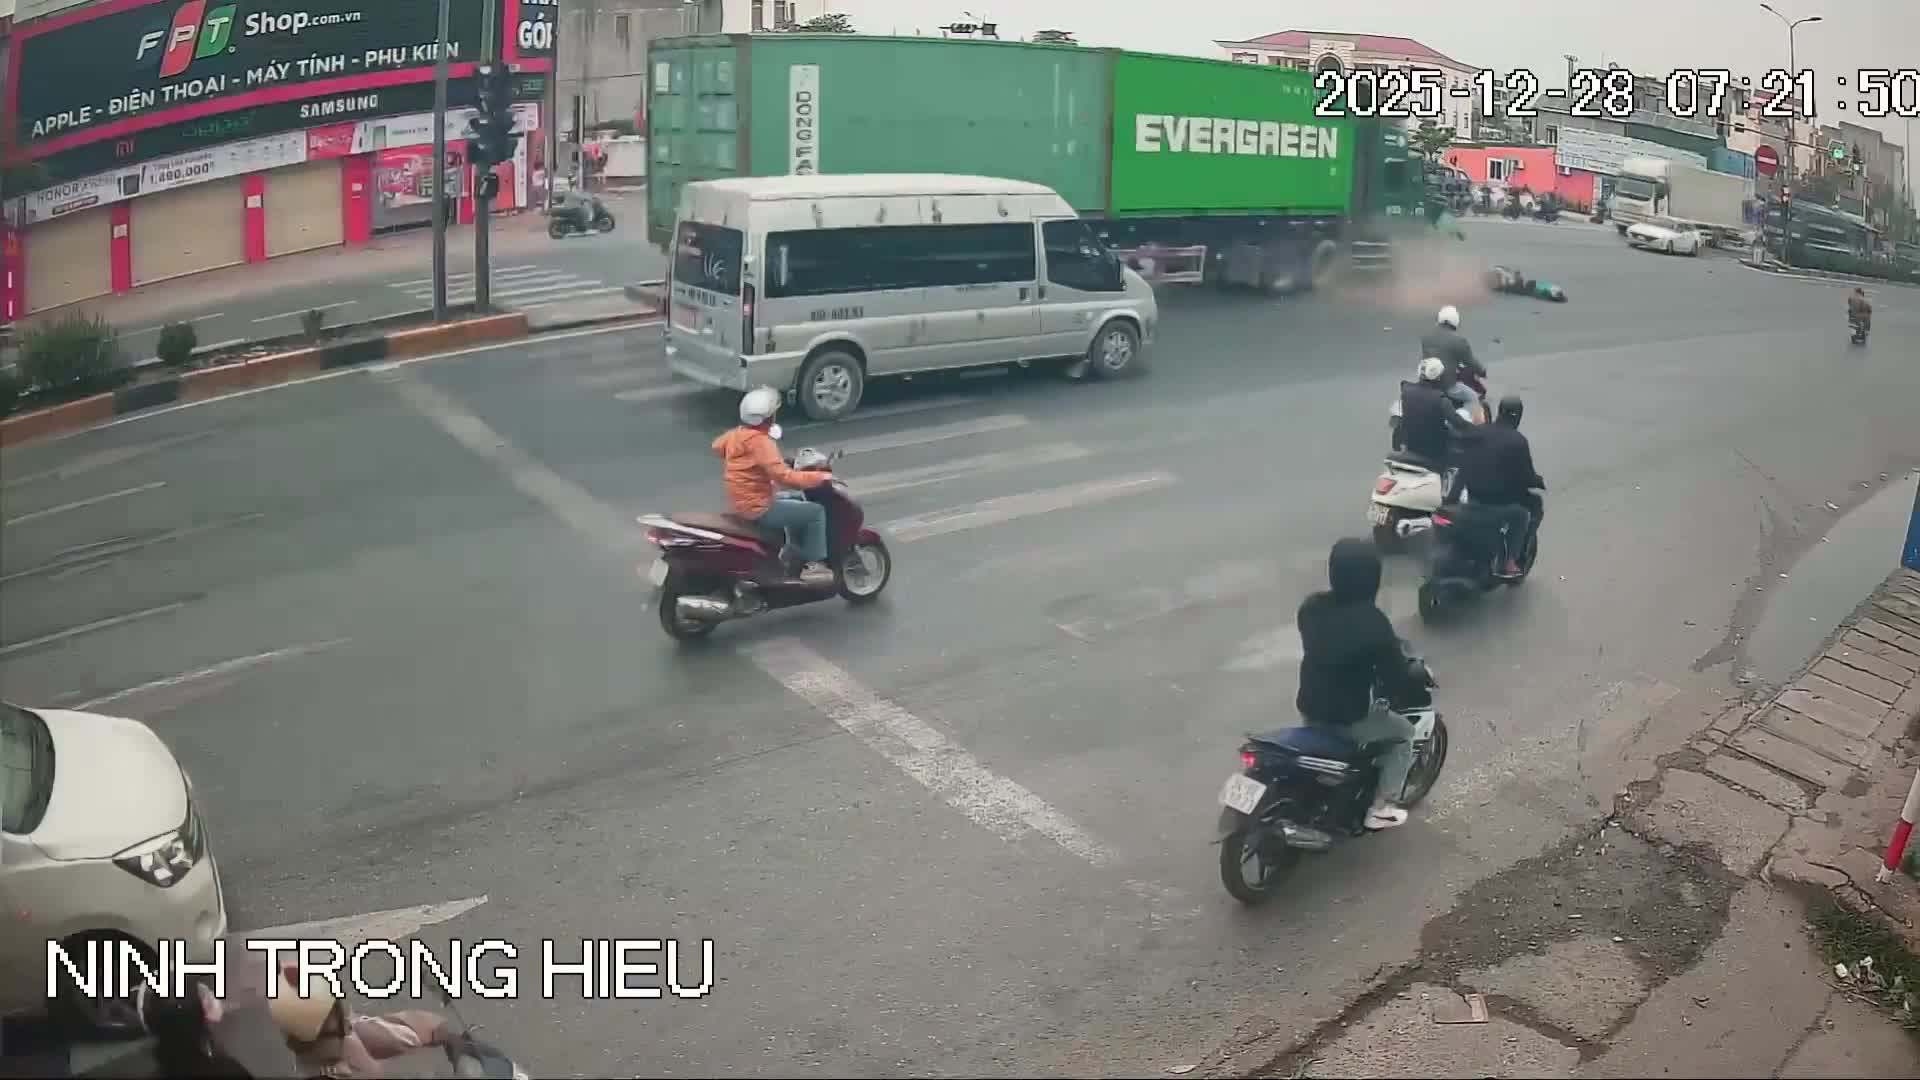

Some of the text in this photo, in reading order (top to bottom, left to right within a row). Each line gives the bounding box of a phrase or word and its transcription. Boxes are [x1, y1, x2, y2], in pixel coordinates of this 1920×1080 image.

[136, 11, 361, 60] FPT Shop.com.vn
[31, 105, 92, 139] APPLE
[108, 87, 155, 116] ĐIỆN
[161, 74, 225, 102] THOẠI
[246, 59, 291, 86] MÁY
[296, 52, 345, 76] TÍNH
[365, 46, 407, 68] PHỤ
[299, 94, 379, 118] SAMSUNG
[1135, 113, 1338, 159] EVERGREEN
